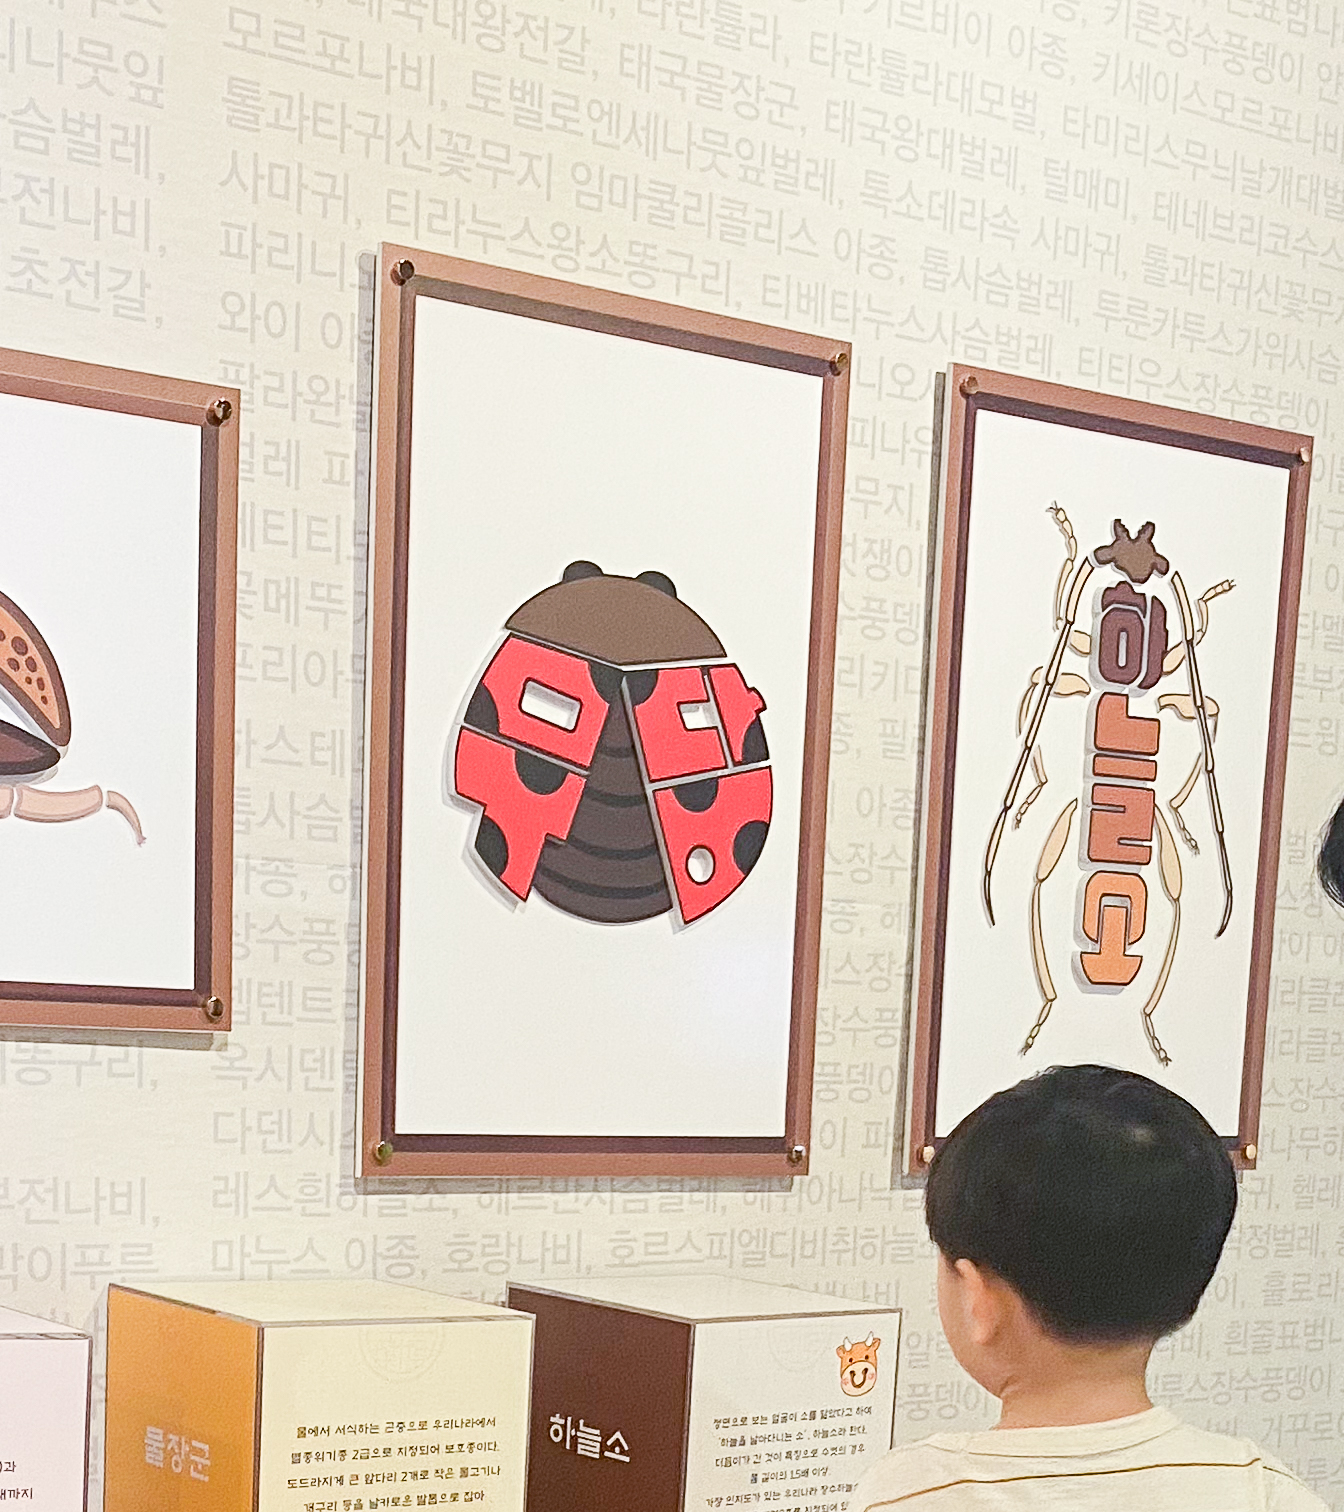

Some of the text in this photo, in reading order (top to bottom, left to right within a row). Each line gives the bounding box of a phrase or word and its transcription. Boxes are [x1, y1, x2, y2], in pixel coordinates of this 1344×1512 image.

[222, 5, 448, 111] 모르포나비,
[1031, 215, 1128, 280] 사마귀,
[617, 40, 808, 137] 태국물장군,
[824, 98, 1026, 196] 태국왕대벌레,
[1042, 156, 1138, 224] 털매미,
[219, 149, 363, 232] 사마귀,
[443, 1229, 595, 1276] 호랑나비,
[143, 1424, 212, 1483] 물장군
[549, 1411, 632, 1465] 하늘소
